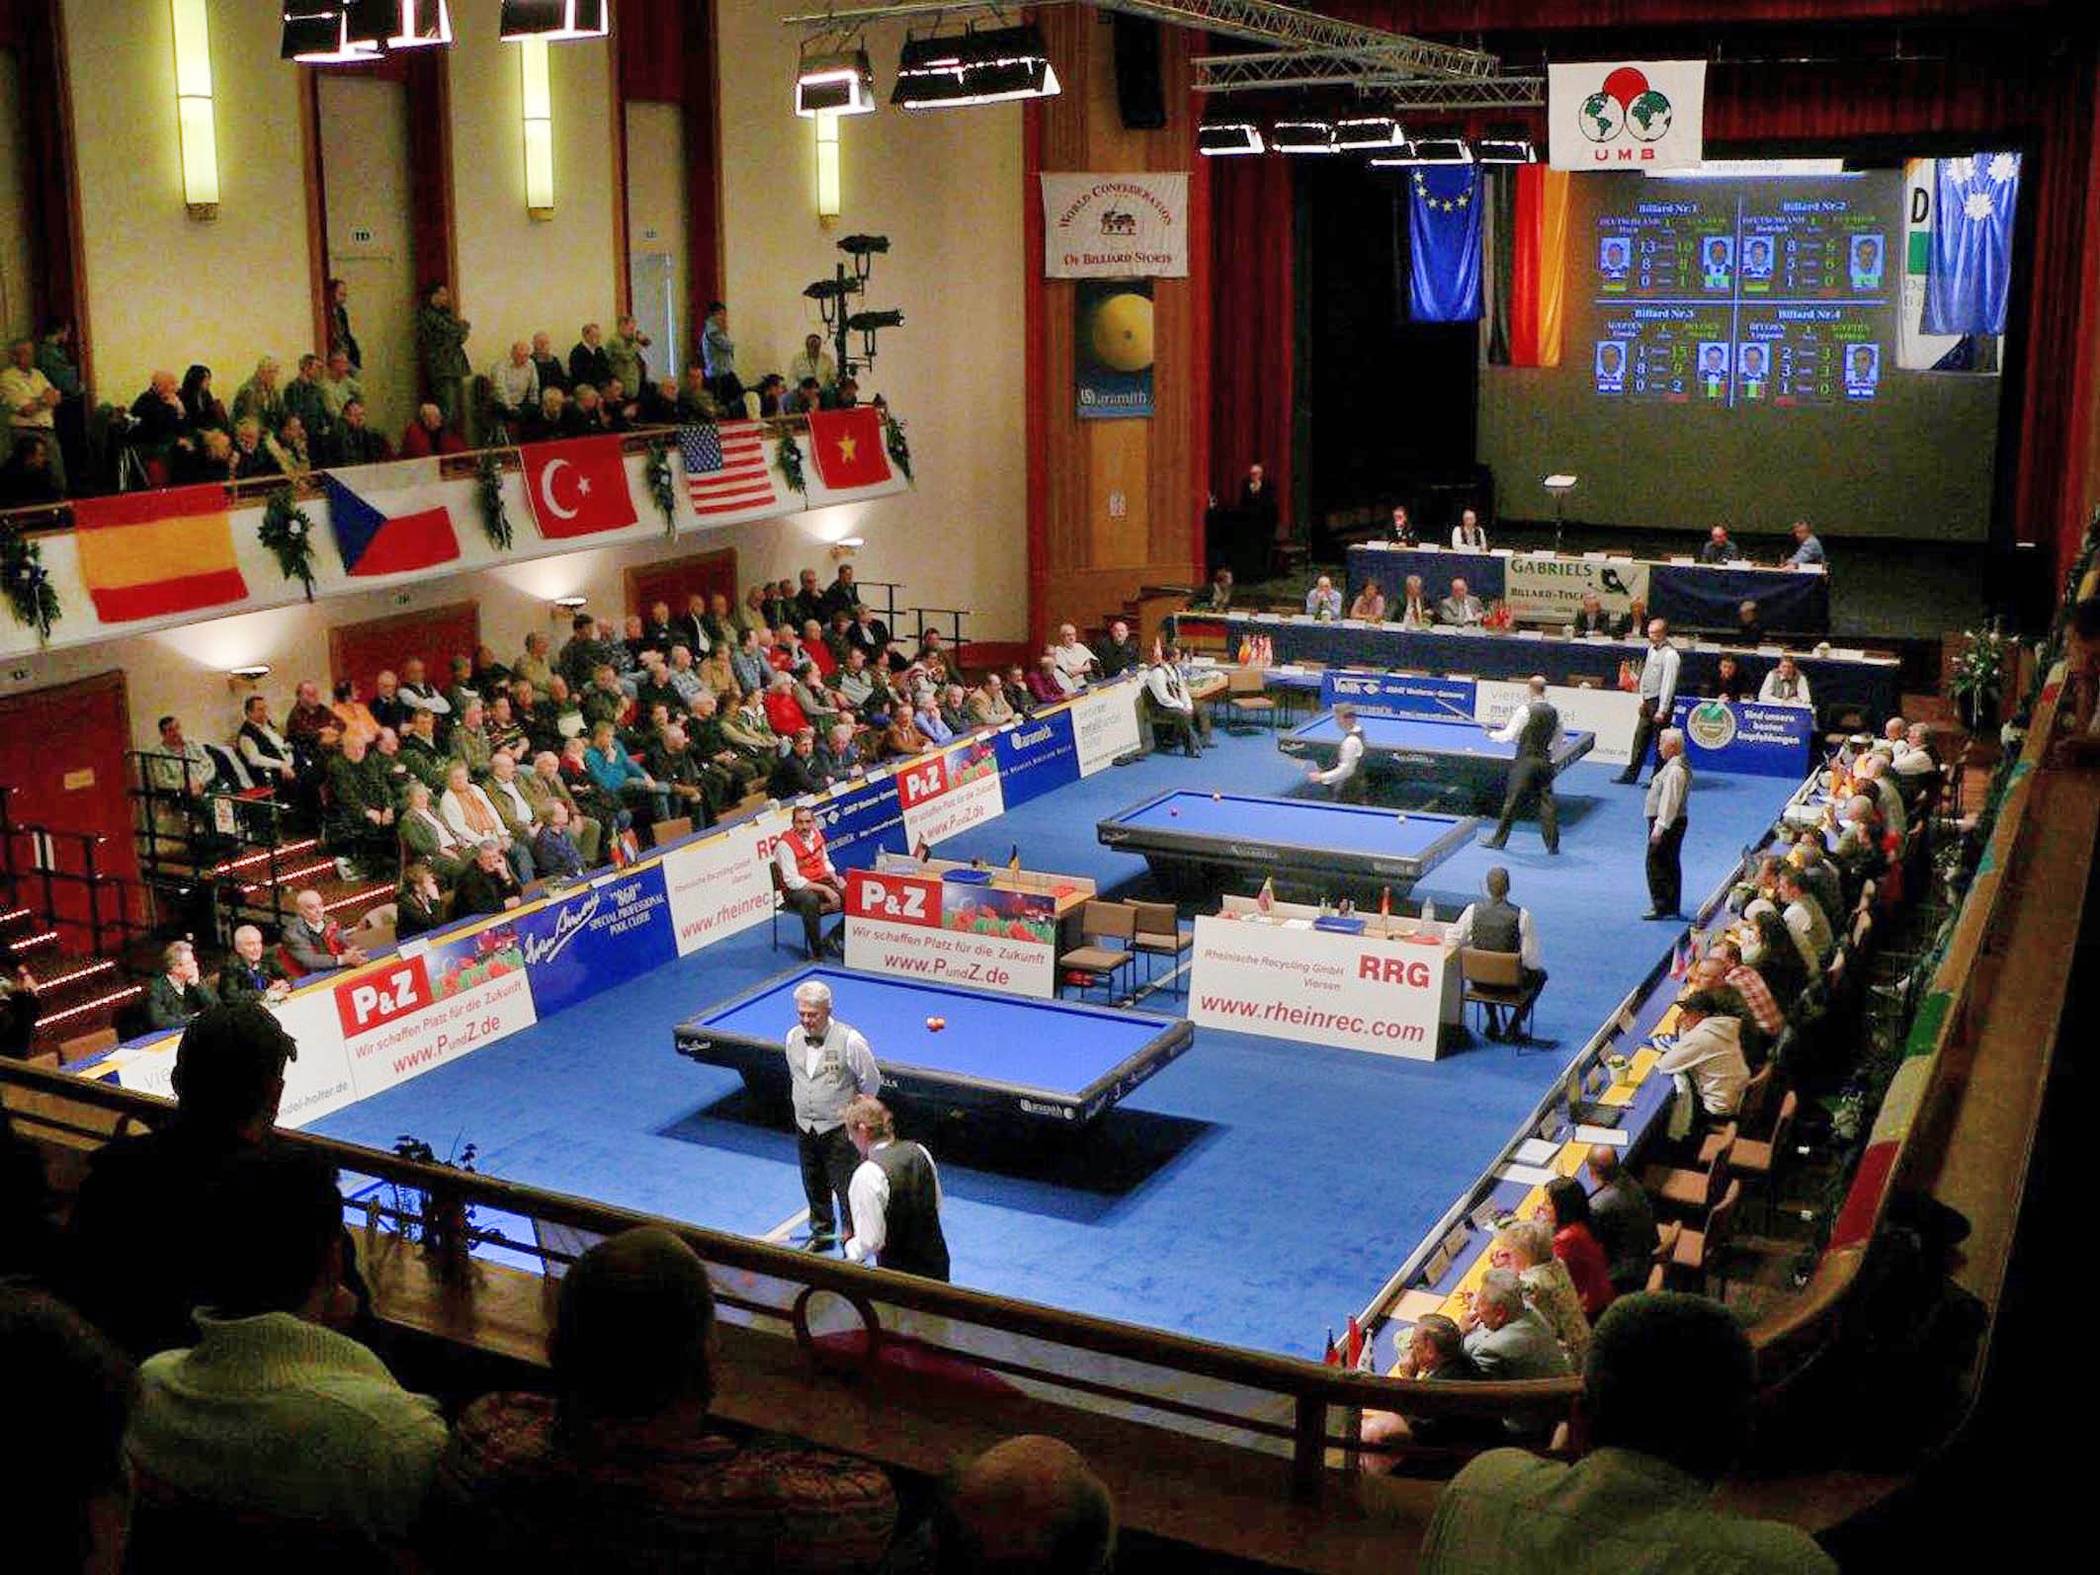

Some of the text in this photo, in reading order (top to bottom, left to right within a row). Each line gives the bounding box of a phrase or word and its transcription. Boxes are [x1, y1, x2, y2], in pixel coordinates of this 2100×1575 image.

[1594, 149, 1655, 160] UMB
[1911, 187, 1929, 223] D
[1511, 560, 1592, 577] GABRIELS
[906, 763, 941, 801] P&Z
[861, 880, 927, 918] P&Z
[853, 925, 870, 938] Wir
[873, 929, 921, 946] schaffen
[924, 936, 951, 951] Platz
[975, 944, 993, 957] die
[999, 946, 1045, 964] Zukunft
[1204, 948, 1345, 976] Rheinische Recycling GmbH
[884, 952, 1009, 986] www.PundZ.de
[1304, 977, 1341, 992] Viersen
[1358, 953, 1431, 989] RRG
[352, 968, 417, 1024] P&Z
[355, 1039, 375, 1060] Wir
[376, 1024, 421, 1051] schaffen
[422, 1013, 447, 1034] Platz
[465, 999, 481, 1020] die
[485, 980, 522, 1007] Zukunft
[1200, 994, 1425, 1042] www.rheinrec.com
[393, 1014, 501, 1075] www.PundZ.de
